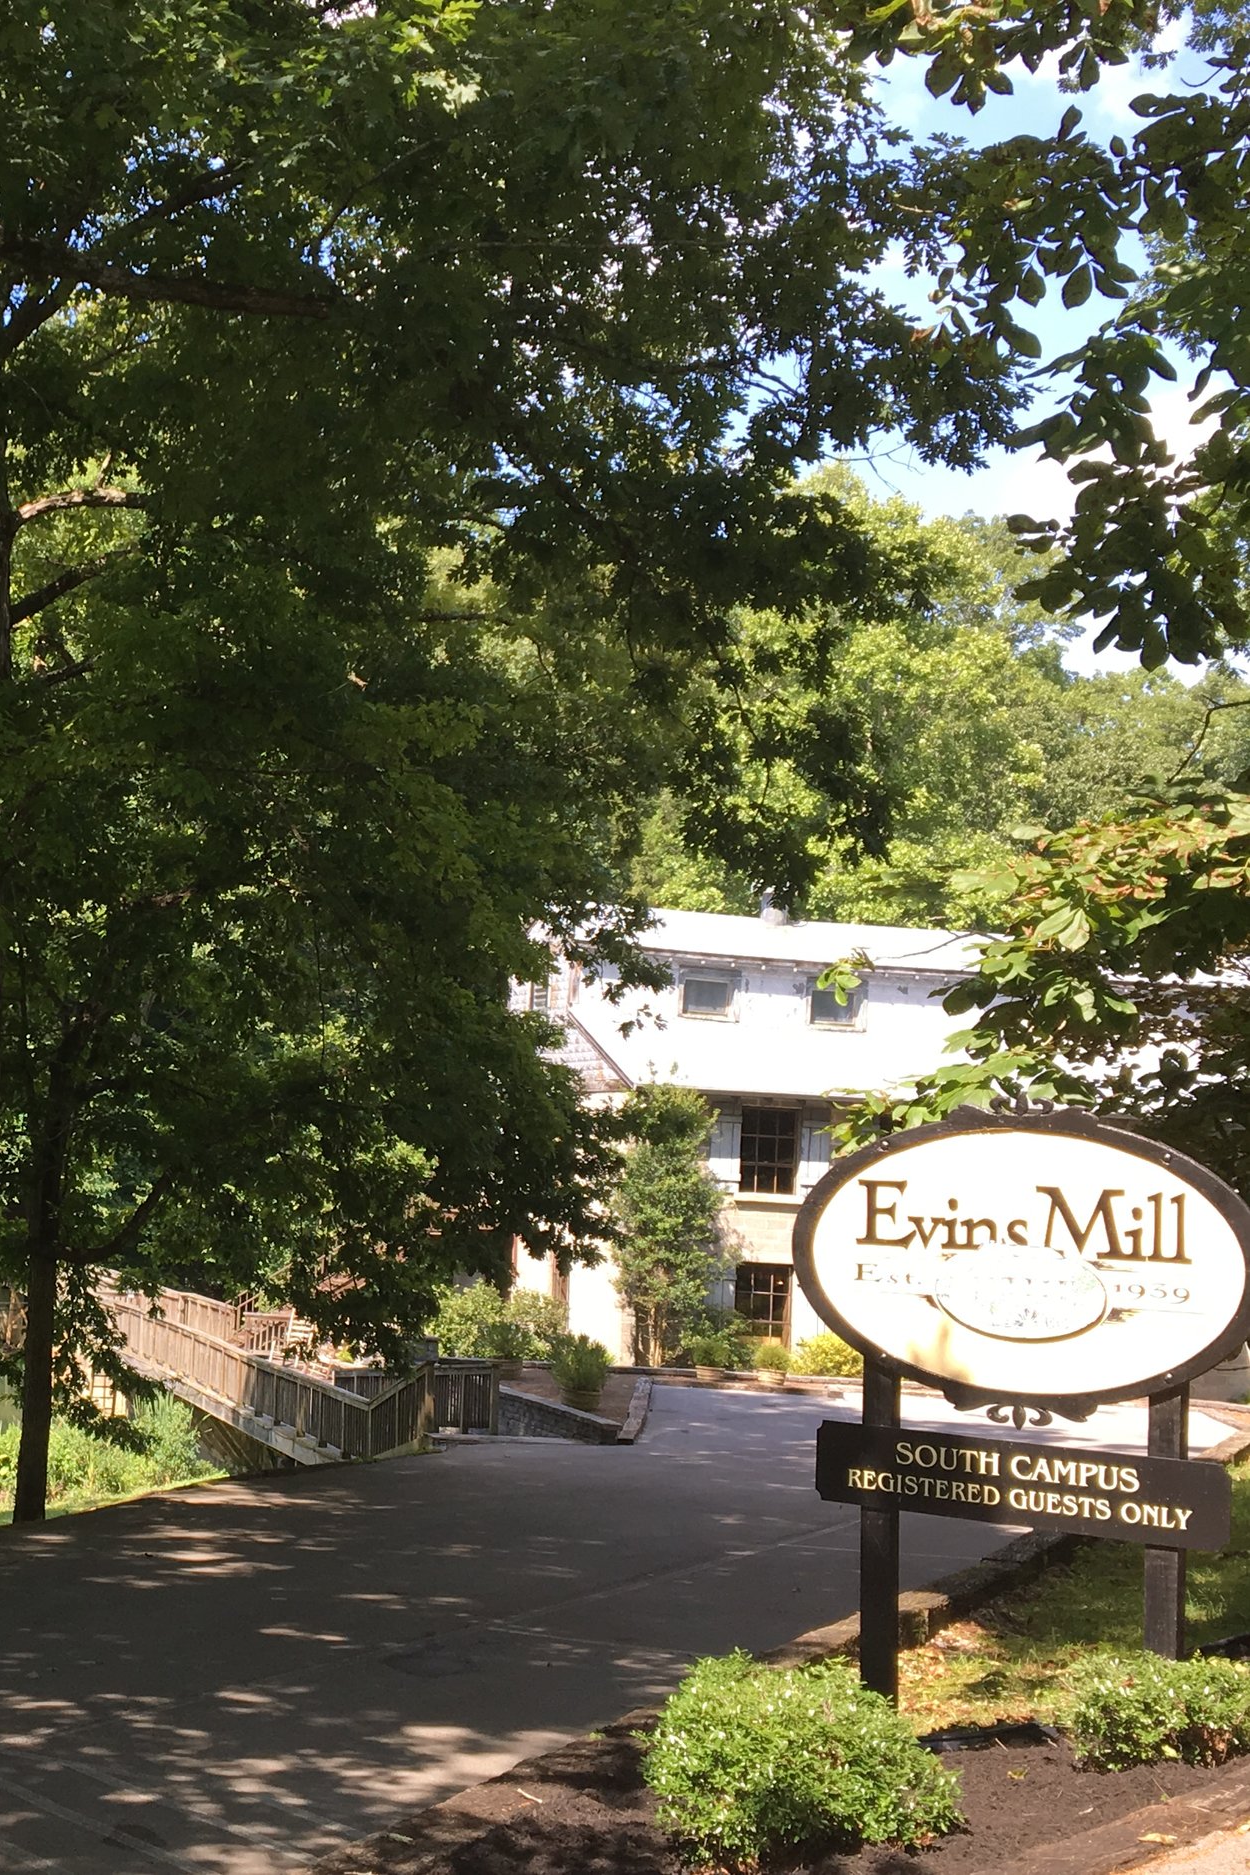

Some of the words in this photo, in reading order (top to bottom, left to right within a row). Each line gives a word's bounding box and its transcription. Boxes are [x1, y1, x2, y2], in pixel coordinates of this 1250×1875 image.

[856, 1179, 1028, 1250] Evins
[1036, 1186, 1192, 1264] Mill
[896, 1442, 1001, 1476] SOUTH
[1010, 1456, 1140, 1493] CAMPUS
[848, 1469, 1001, 1506] REGISTERED
[1009, 1488, 1112, 1520] GUESTS
[1121, 1502, 1193, 1530] ONLY
